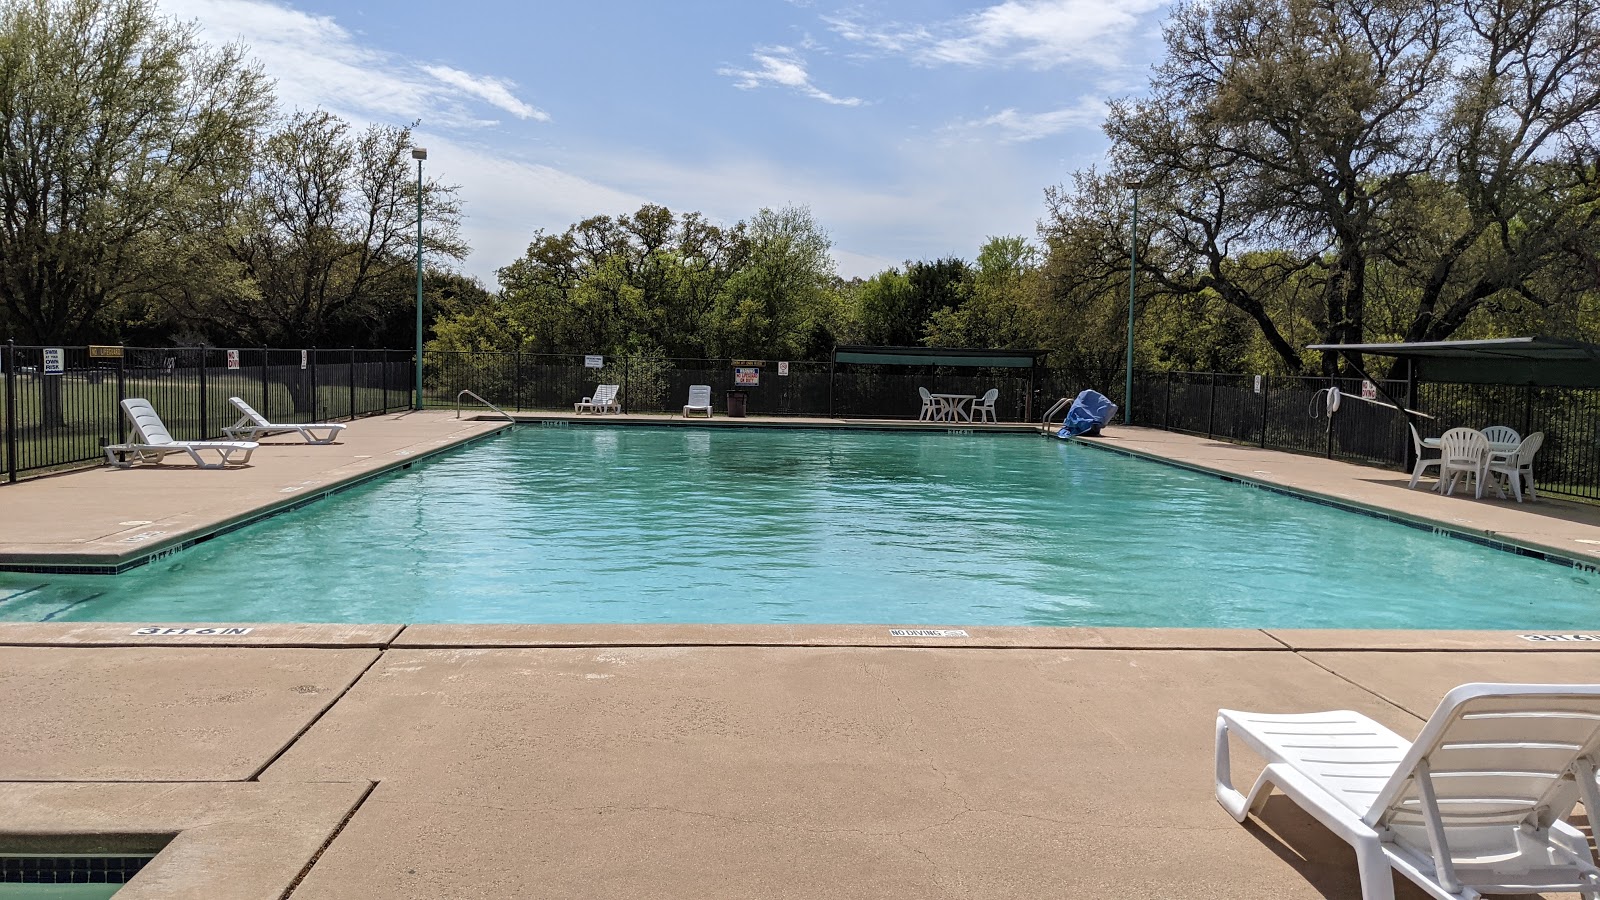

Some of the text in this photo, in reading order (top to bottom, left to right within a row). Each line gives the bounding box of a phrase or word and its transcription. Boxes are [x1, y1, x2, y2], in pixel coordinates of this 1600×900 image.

[100, 348, 121, 356] LIFEGUARD
[228, 351, 235, 359] NO
[1362, 389, 1375, 397] DIVING
[158, 550, 167, 560] FT
[1585, 564, 1596, 573] FT
